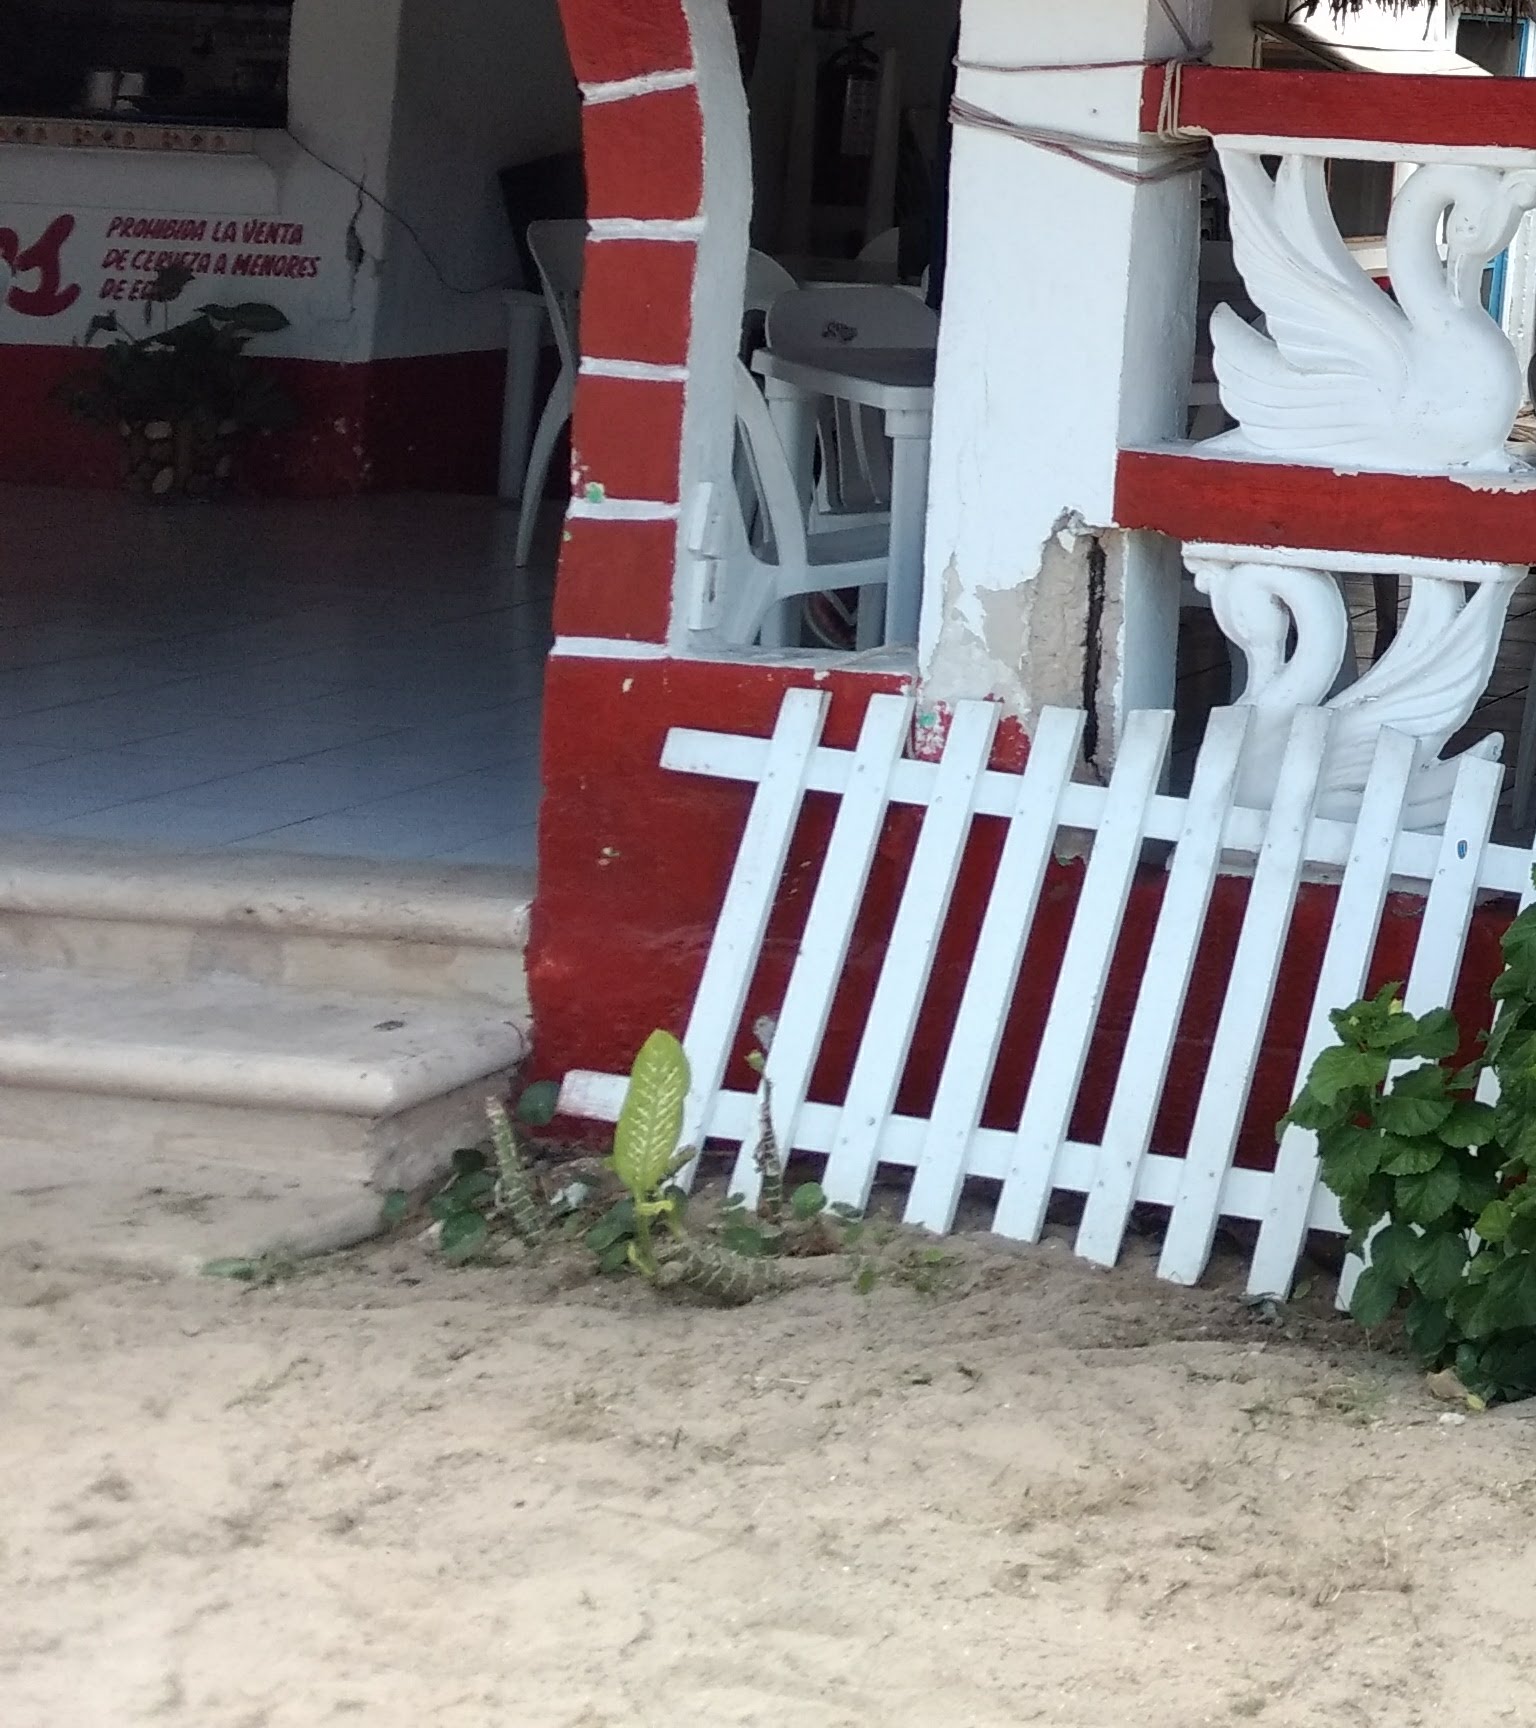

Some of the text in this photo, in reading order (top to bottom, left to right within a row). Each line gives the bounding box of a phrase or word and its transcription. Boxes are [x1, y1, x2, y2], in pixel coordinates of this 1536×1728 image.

[211, 220, 237, 243] LA
[242, 219, 304, 245] VENTA
[102, 249, 130, 270] DE
[213, 253, 227, 274] A
[231, 253, 321, 279] MENORES
[99, 278, 128, 301] DE
